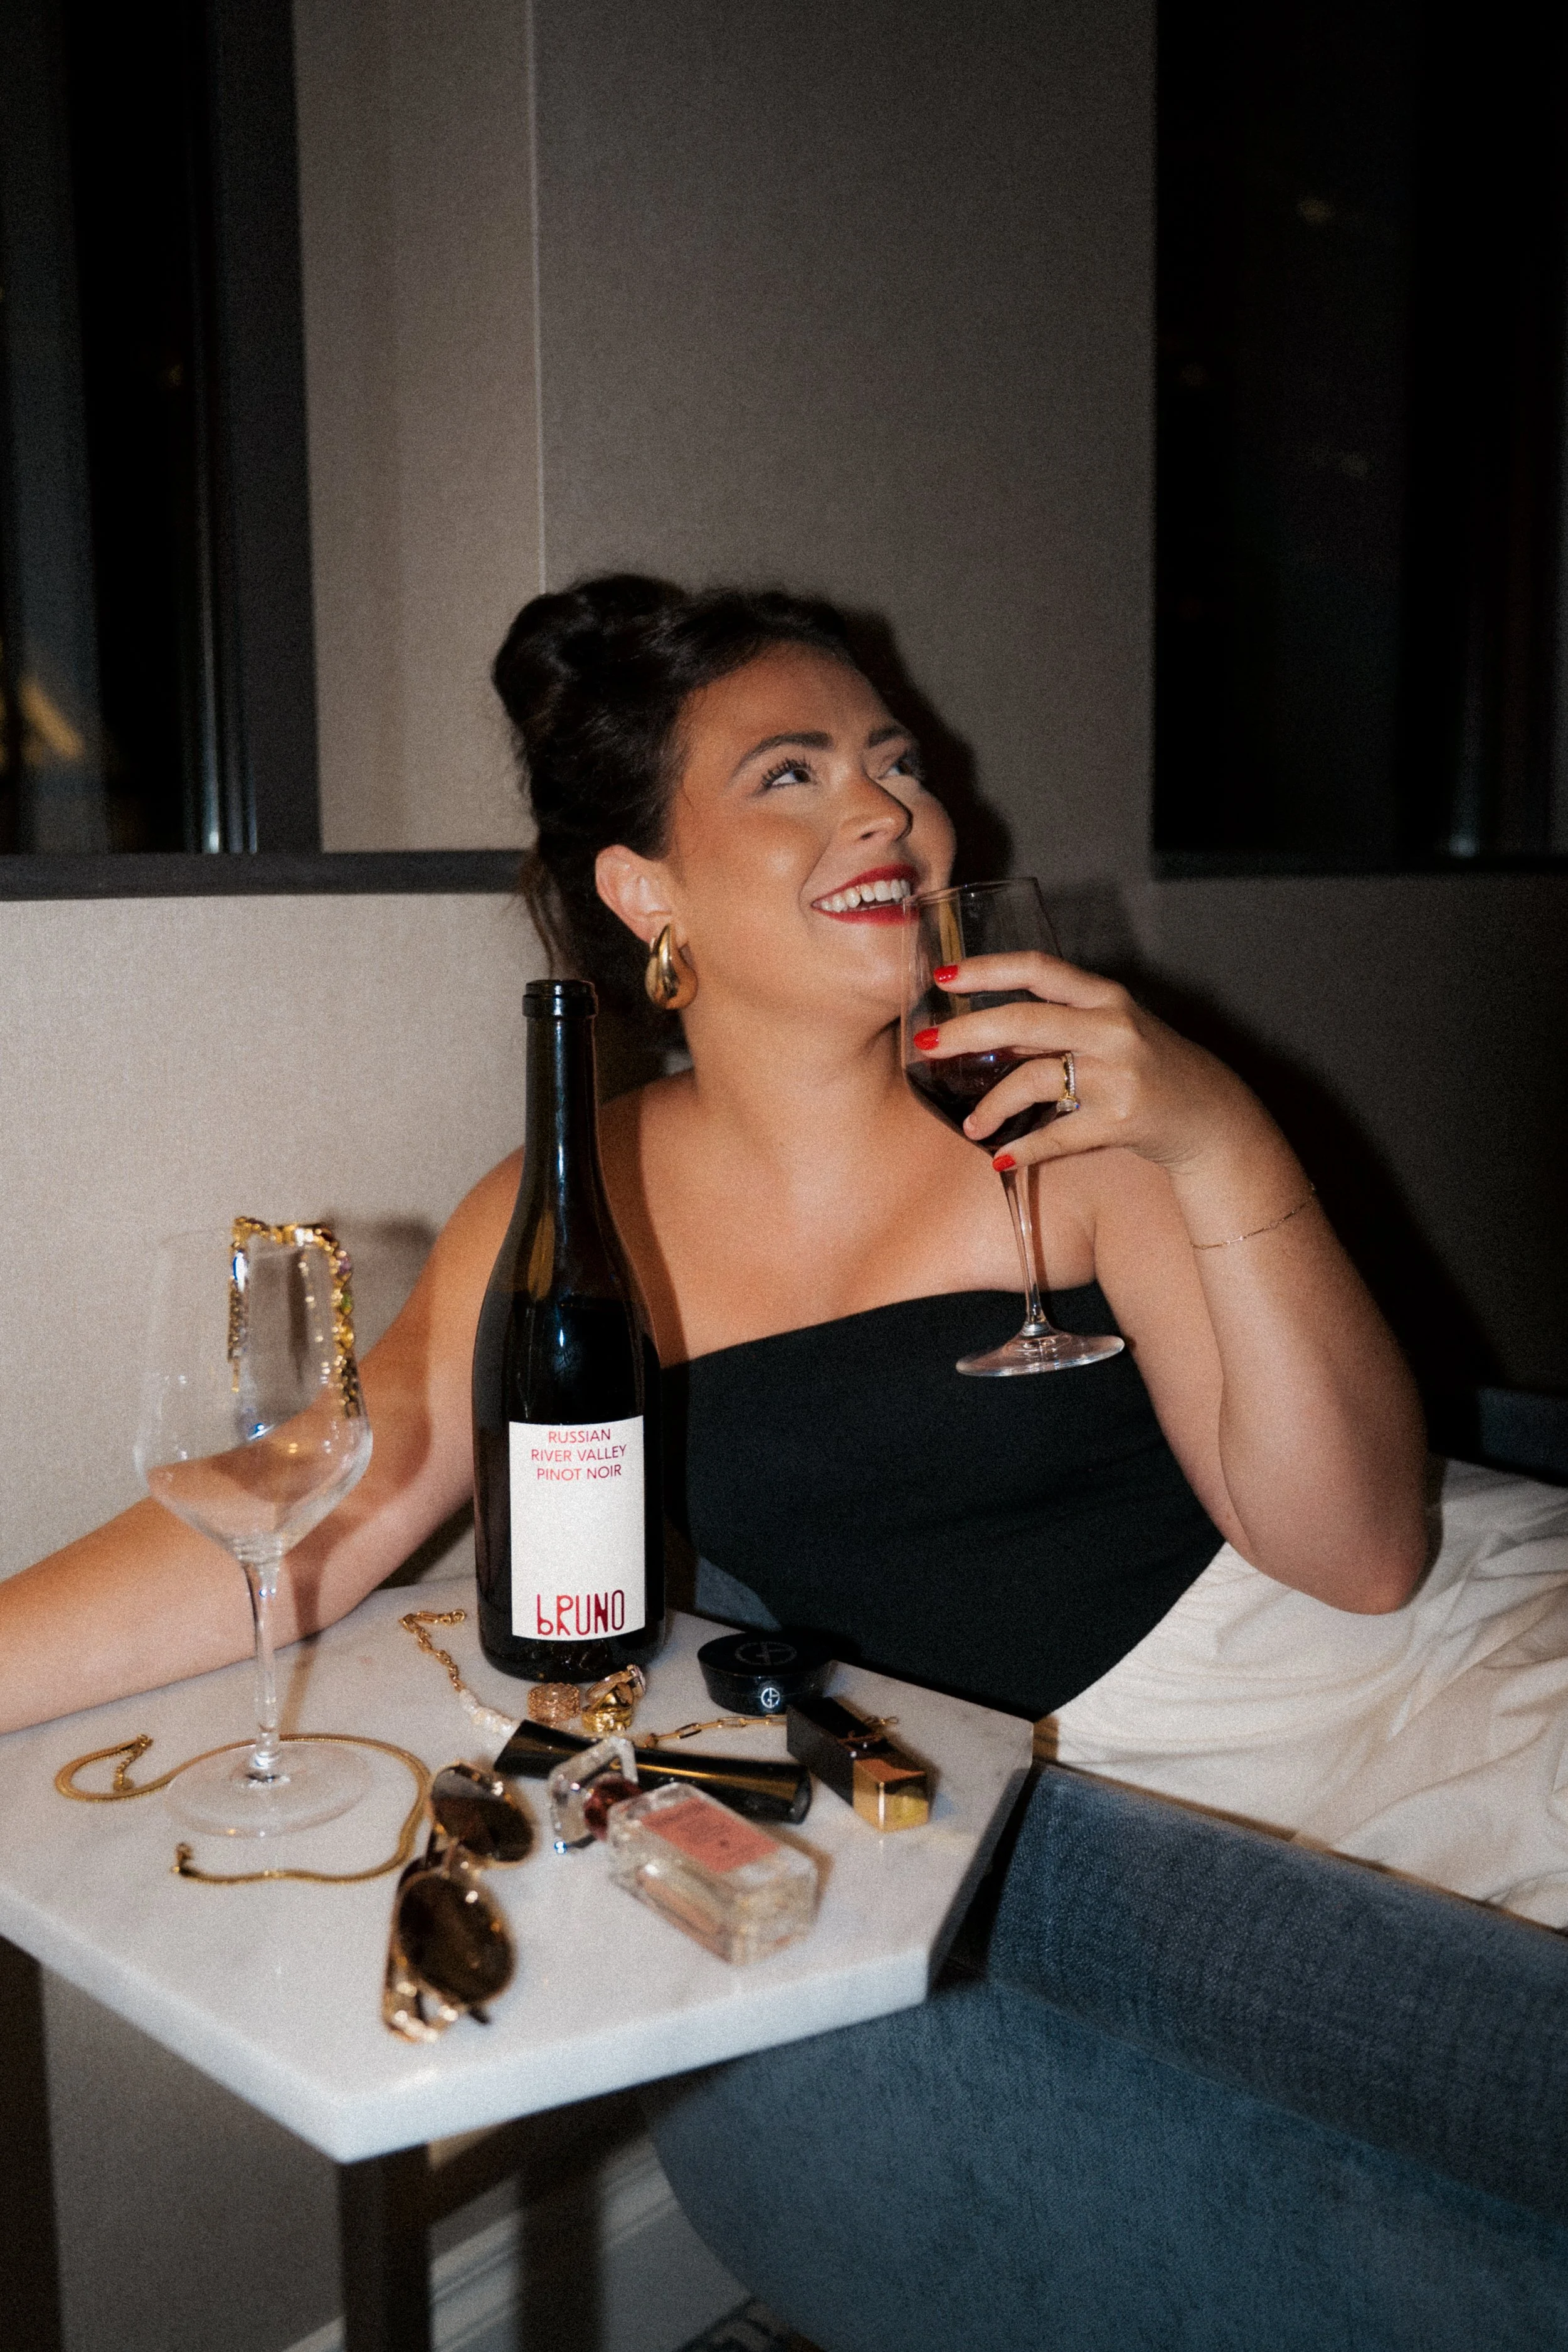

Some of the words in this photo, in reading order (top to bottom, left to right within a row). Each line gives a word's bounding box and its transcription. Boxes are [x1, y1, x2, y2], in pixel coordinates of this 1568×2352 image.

[549, 1429, 610, 1444] RUSSIAN
[532, 1449, 571, 1461] RIVER
[578, 1444, 627, 1461] VALLEY
[538, 1468, 582, 1480] PINOT
[587, 1464, 622, 1479] NOIR
